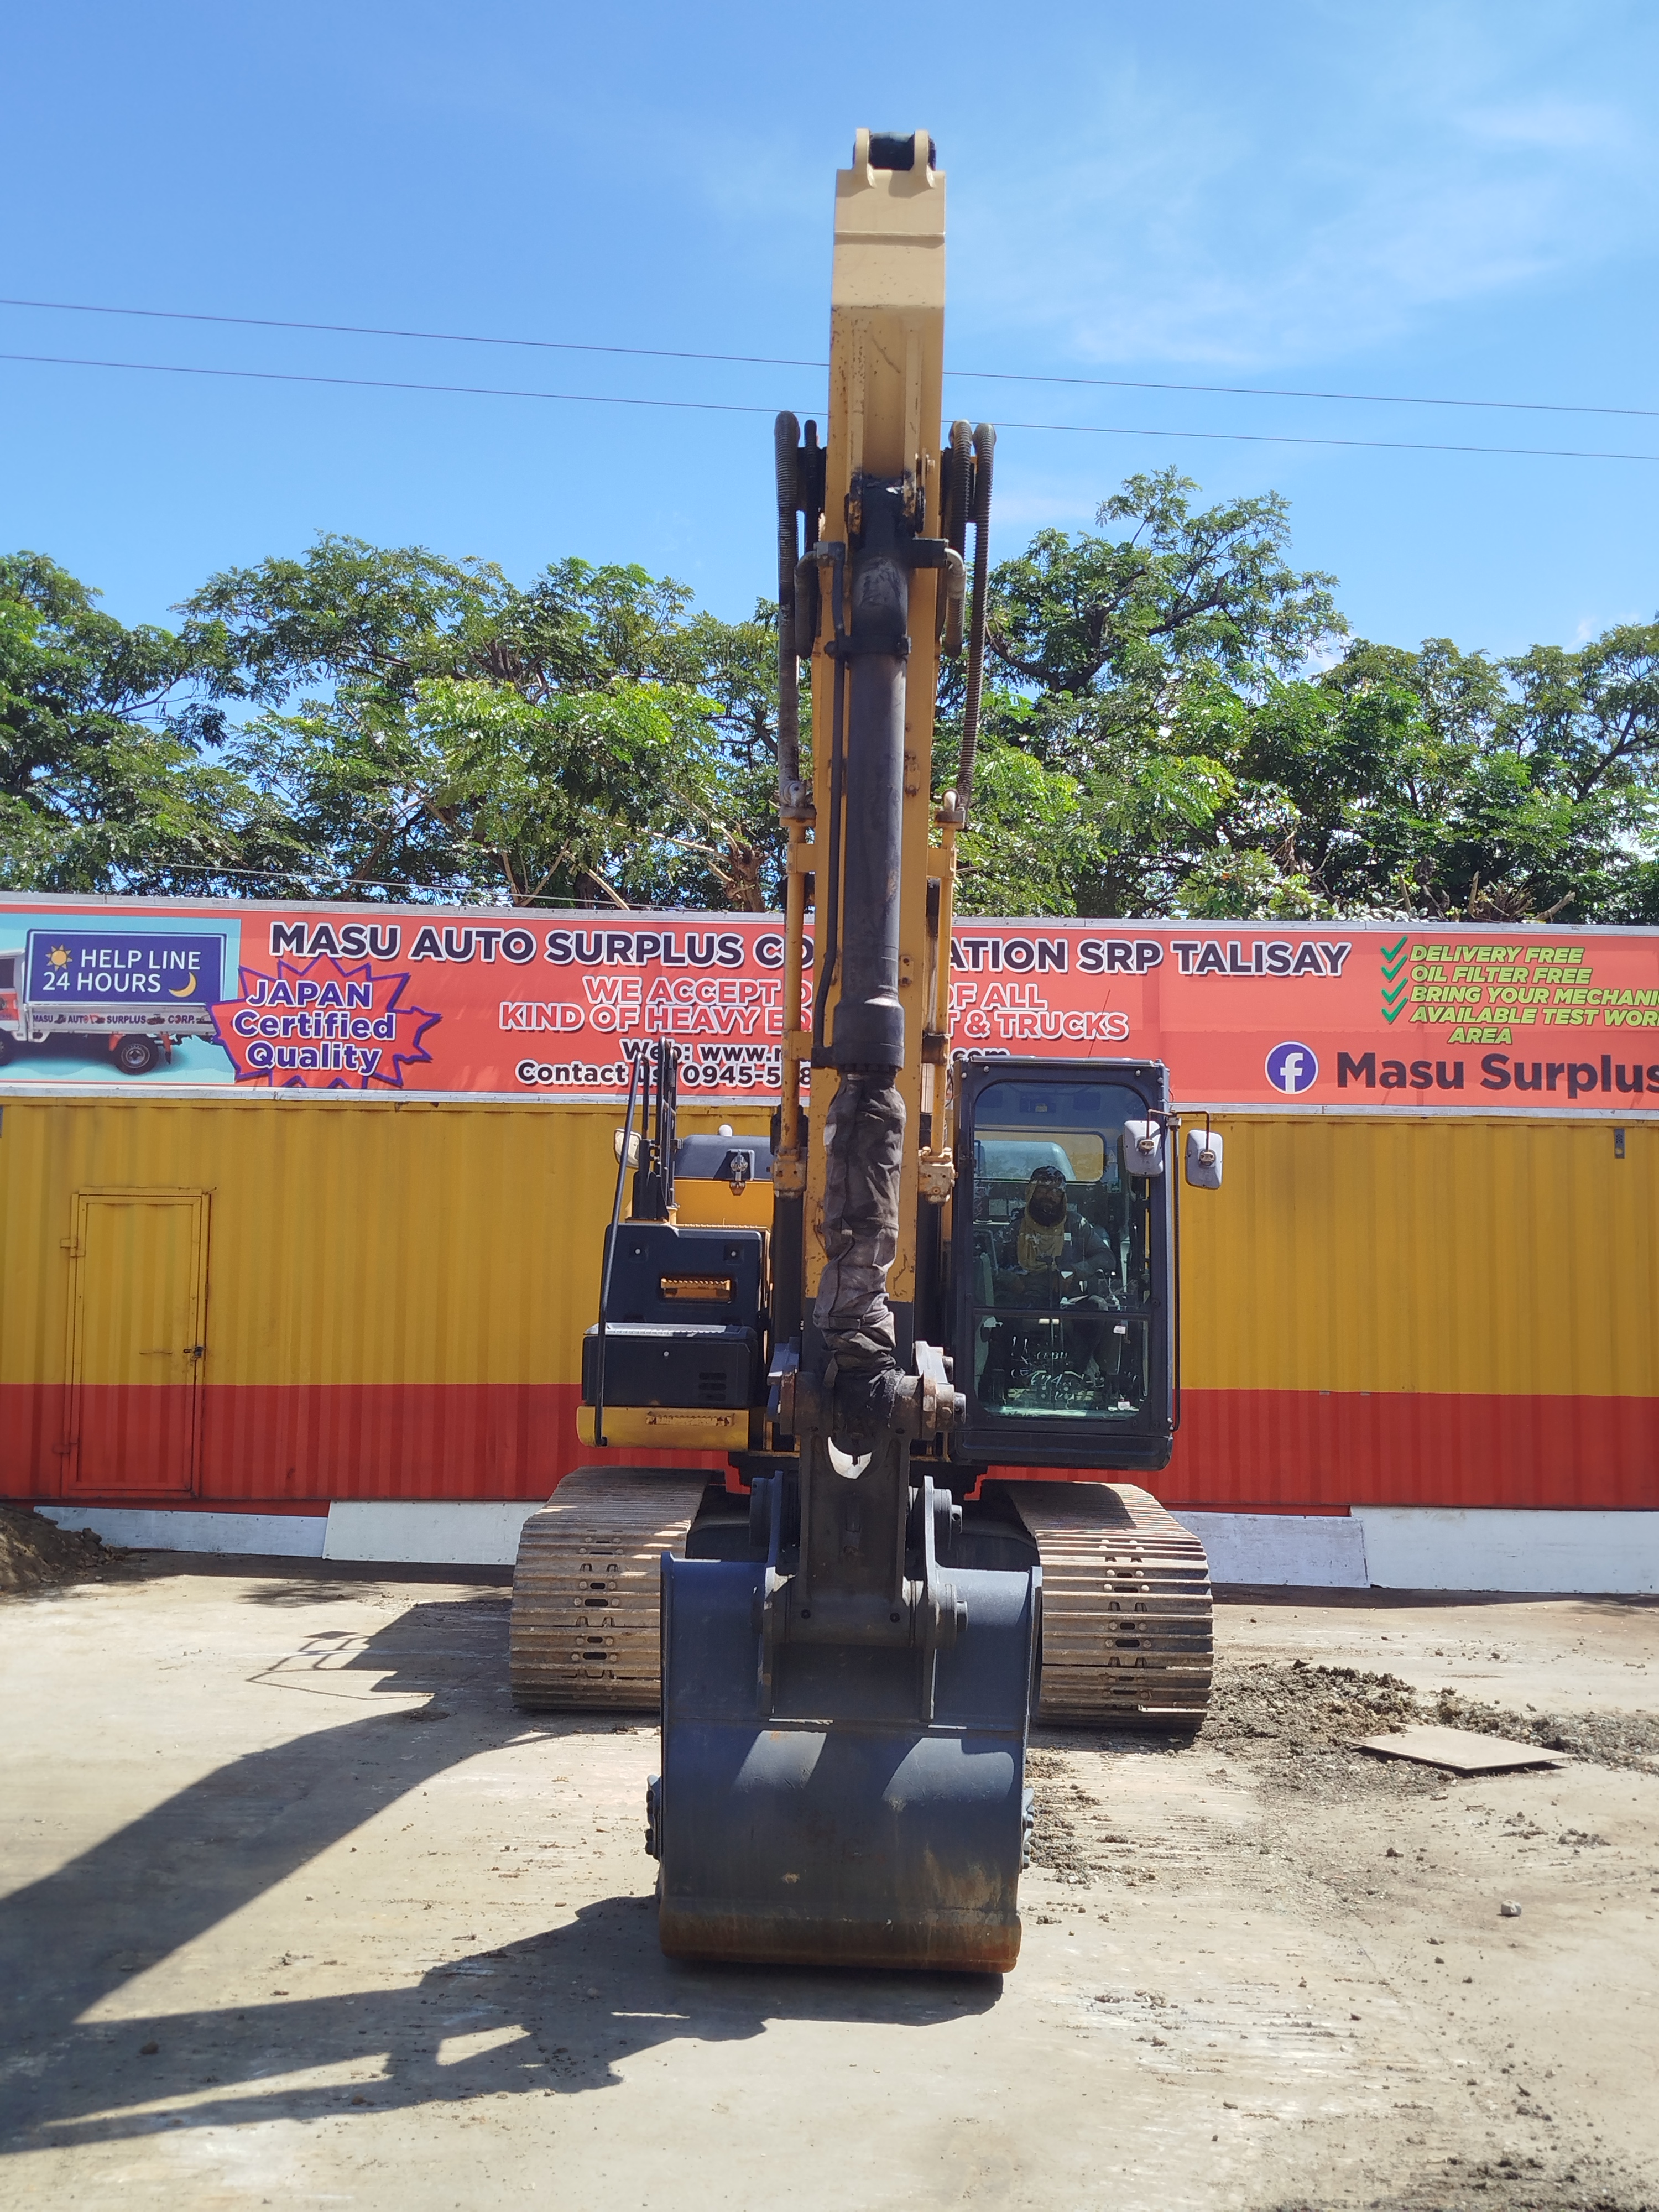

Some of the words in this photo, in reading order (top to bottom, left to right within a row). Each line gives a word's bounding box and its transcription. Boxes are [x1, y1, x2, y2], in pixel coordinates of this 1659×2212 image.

[81, 949, 142, 969] HELP
[149, 951, 201, 970] LINE
[269, 921, 401, 960] MASU
[409, 926, 536, 964] AUTO
[544, 930, 745, 968] SURPLUS
[1077, 940, 1163, 975] SRP
[1171, 940, 1352, 977] TALISAY
[1410, 945, 1522, 964] DELIVERY
[1524, 947, 1585, 964] FREE
[43, 972, 71, 991] 24
[77, 972, 161, 993] HOURS
[1410, 966, 1448, 983] OIL
[1452, 966, 1530, 984] FILTER
[1532, 967, 1593, 985] FREE
[246, 980, 373, 1010] JAPAN
[583, 976, 642, 1004] WE
[646, 978, 781, 1006] ACCEPT
[980, 983, 1047, 1010] ALL
[1410, 986, 1481, 1004] BRING
[1487, 987, 1550, 1005] YOUR
[1553, 988, 1659, 1006] MECHANI
[107, 1015, 146, 1024] SURPLUS
[232, 1009, 396, 1040] Certified
[498, 1001, 585, 1031] KIND
[589, 1004, 640, 1032] OF
[645, 1005, 761, 1035] HEAVY
[964, 1009, 991, 1038] &
[994, 1011, 1129, 1040] TRUCKS
[1410, 1005, 1538, 1025] AVAILABLE
[1542, 1008, 1600, 1026] TEST
[1604, 1009, 1659, 1027] WOR
[1448, 1027, 1513, 1045] AREA
[246, 1040, 382, 1076] Quality
[1337, 1052, 1464, 1089] Masu
[515, 1060, 628, 1086] Contact
